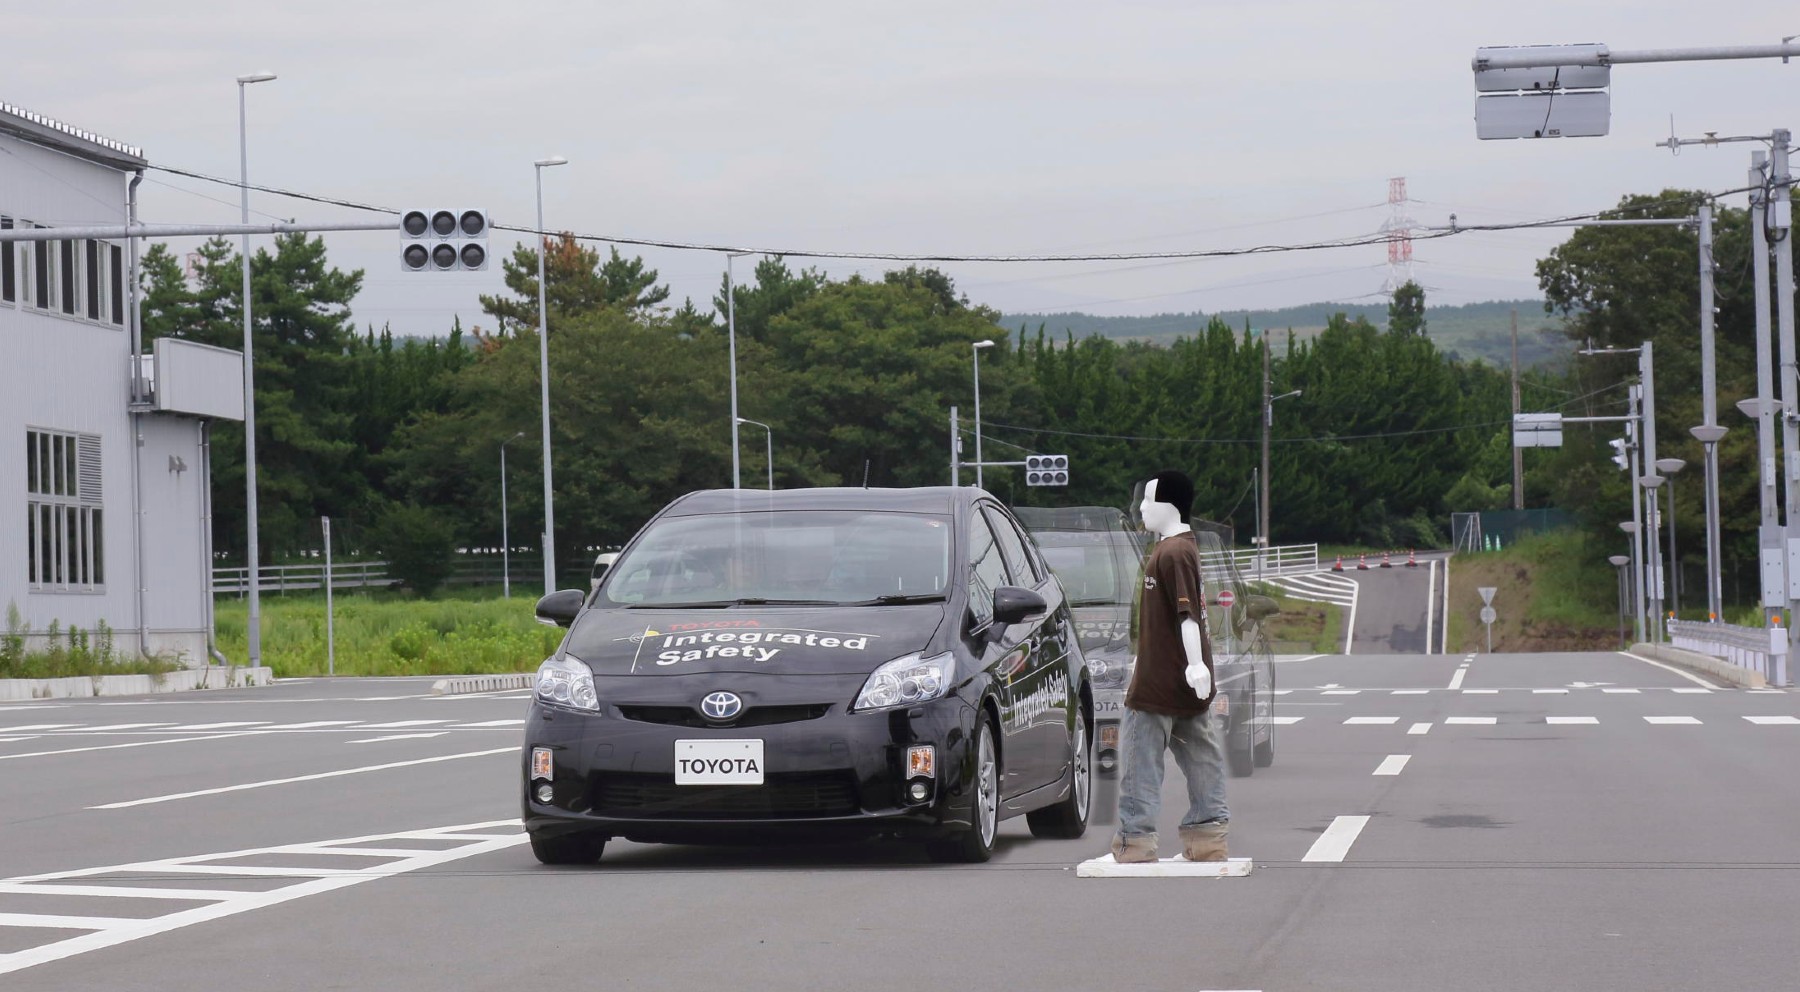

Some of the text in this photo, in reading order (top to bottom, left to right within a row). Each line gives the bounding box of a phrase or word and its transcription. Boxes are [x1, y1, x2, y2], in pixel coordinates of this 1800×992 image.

[670, 620, 760, 631] TOYOTA
[662, 631, 868, 651] Integrated
[1078, 629, 1128, 641] fety
[656, 644, 781, 666] Safety
[1013, 668, 1067, 728] Integrated Safety
[1094, 701, 1120, 713] OTA
[679, 759, 759, 774] TOYOTA
